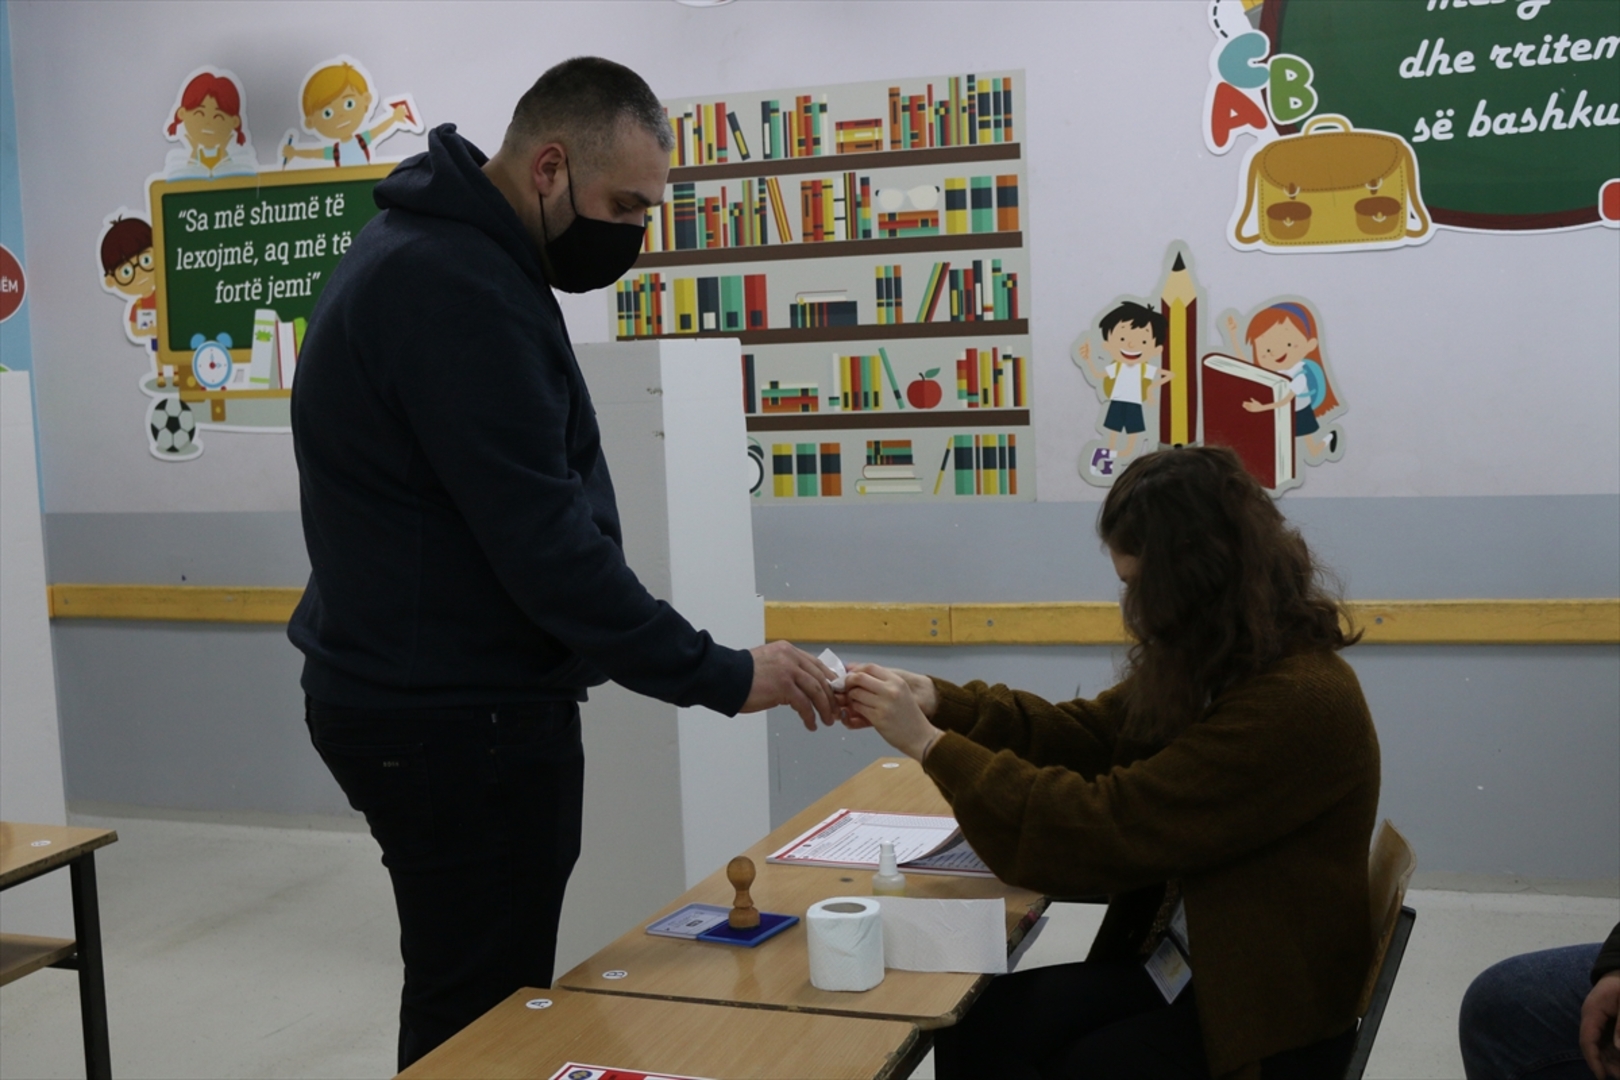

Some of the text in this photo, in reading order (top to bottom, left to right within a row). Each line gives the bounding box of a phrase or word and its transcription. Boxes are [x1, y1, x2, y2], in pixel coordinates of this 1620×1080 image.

[1399, 37, 1476, 79] dhe
[1412, 108, 1455, 143] së
[213, 204, 245, 229] më
[250, 196, 320, 226] shumë
[325, 193, 345, 218] të
[176, 231, 352, 272] lexojmë, aq më të
[215, 277, 263, 304] fortë
